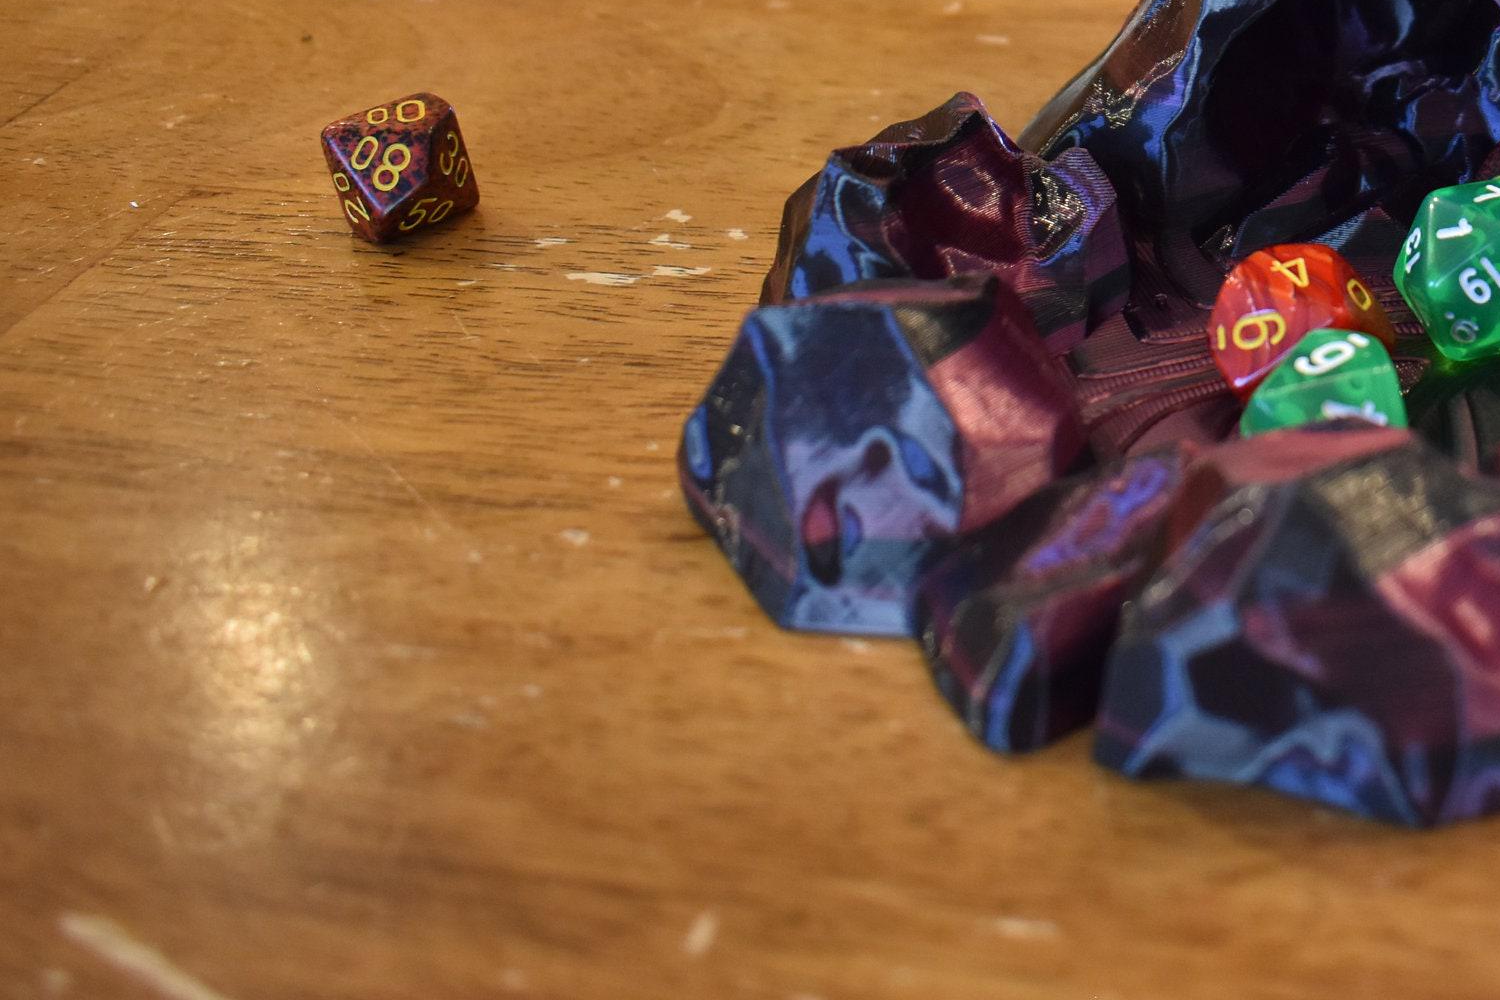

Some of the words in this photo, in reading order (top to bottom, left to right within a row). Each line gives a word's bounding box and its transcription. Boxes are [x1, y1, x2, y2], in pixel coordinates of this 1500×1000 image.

[399, 197, 454, 231] 50
[1436, 217, 1473, 239] 1
[1270, 257, 1310, 287] 4
[1346, 278, 1372, 311] 0
